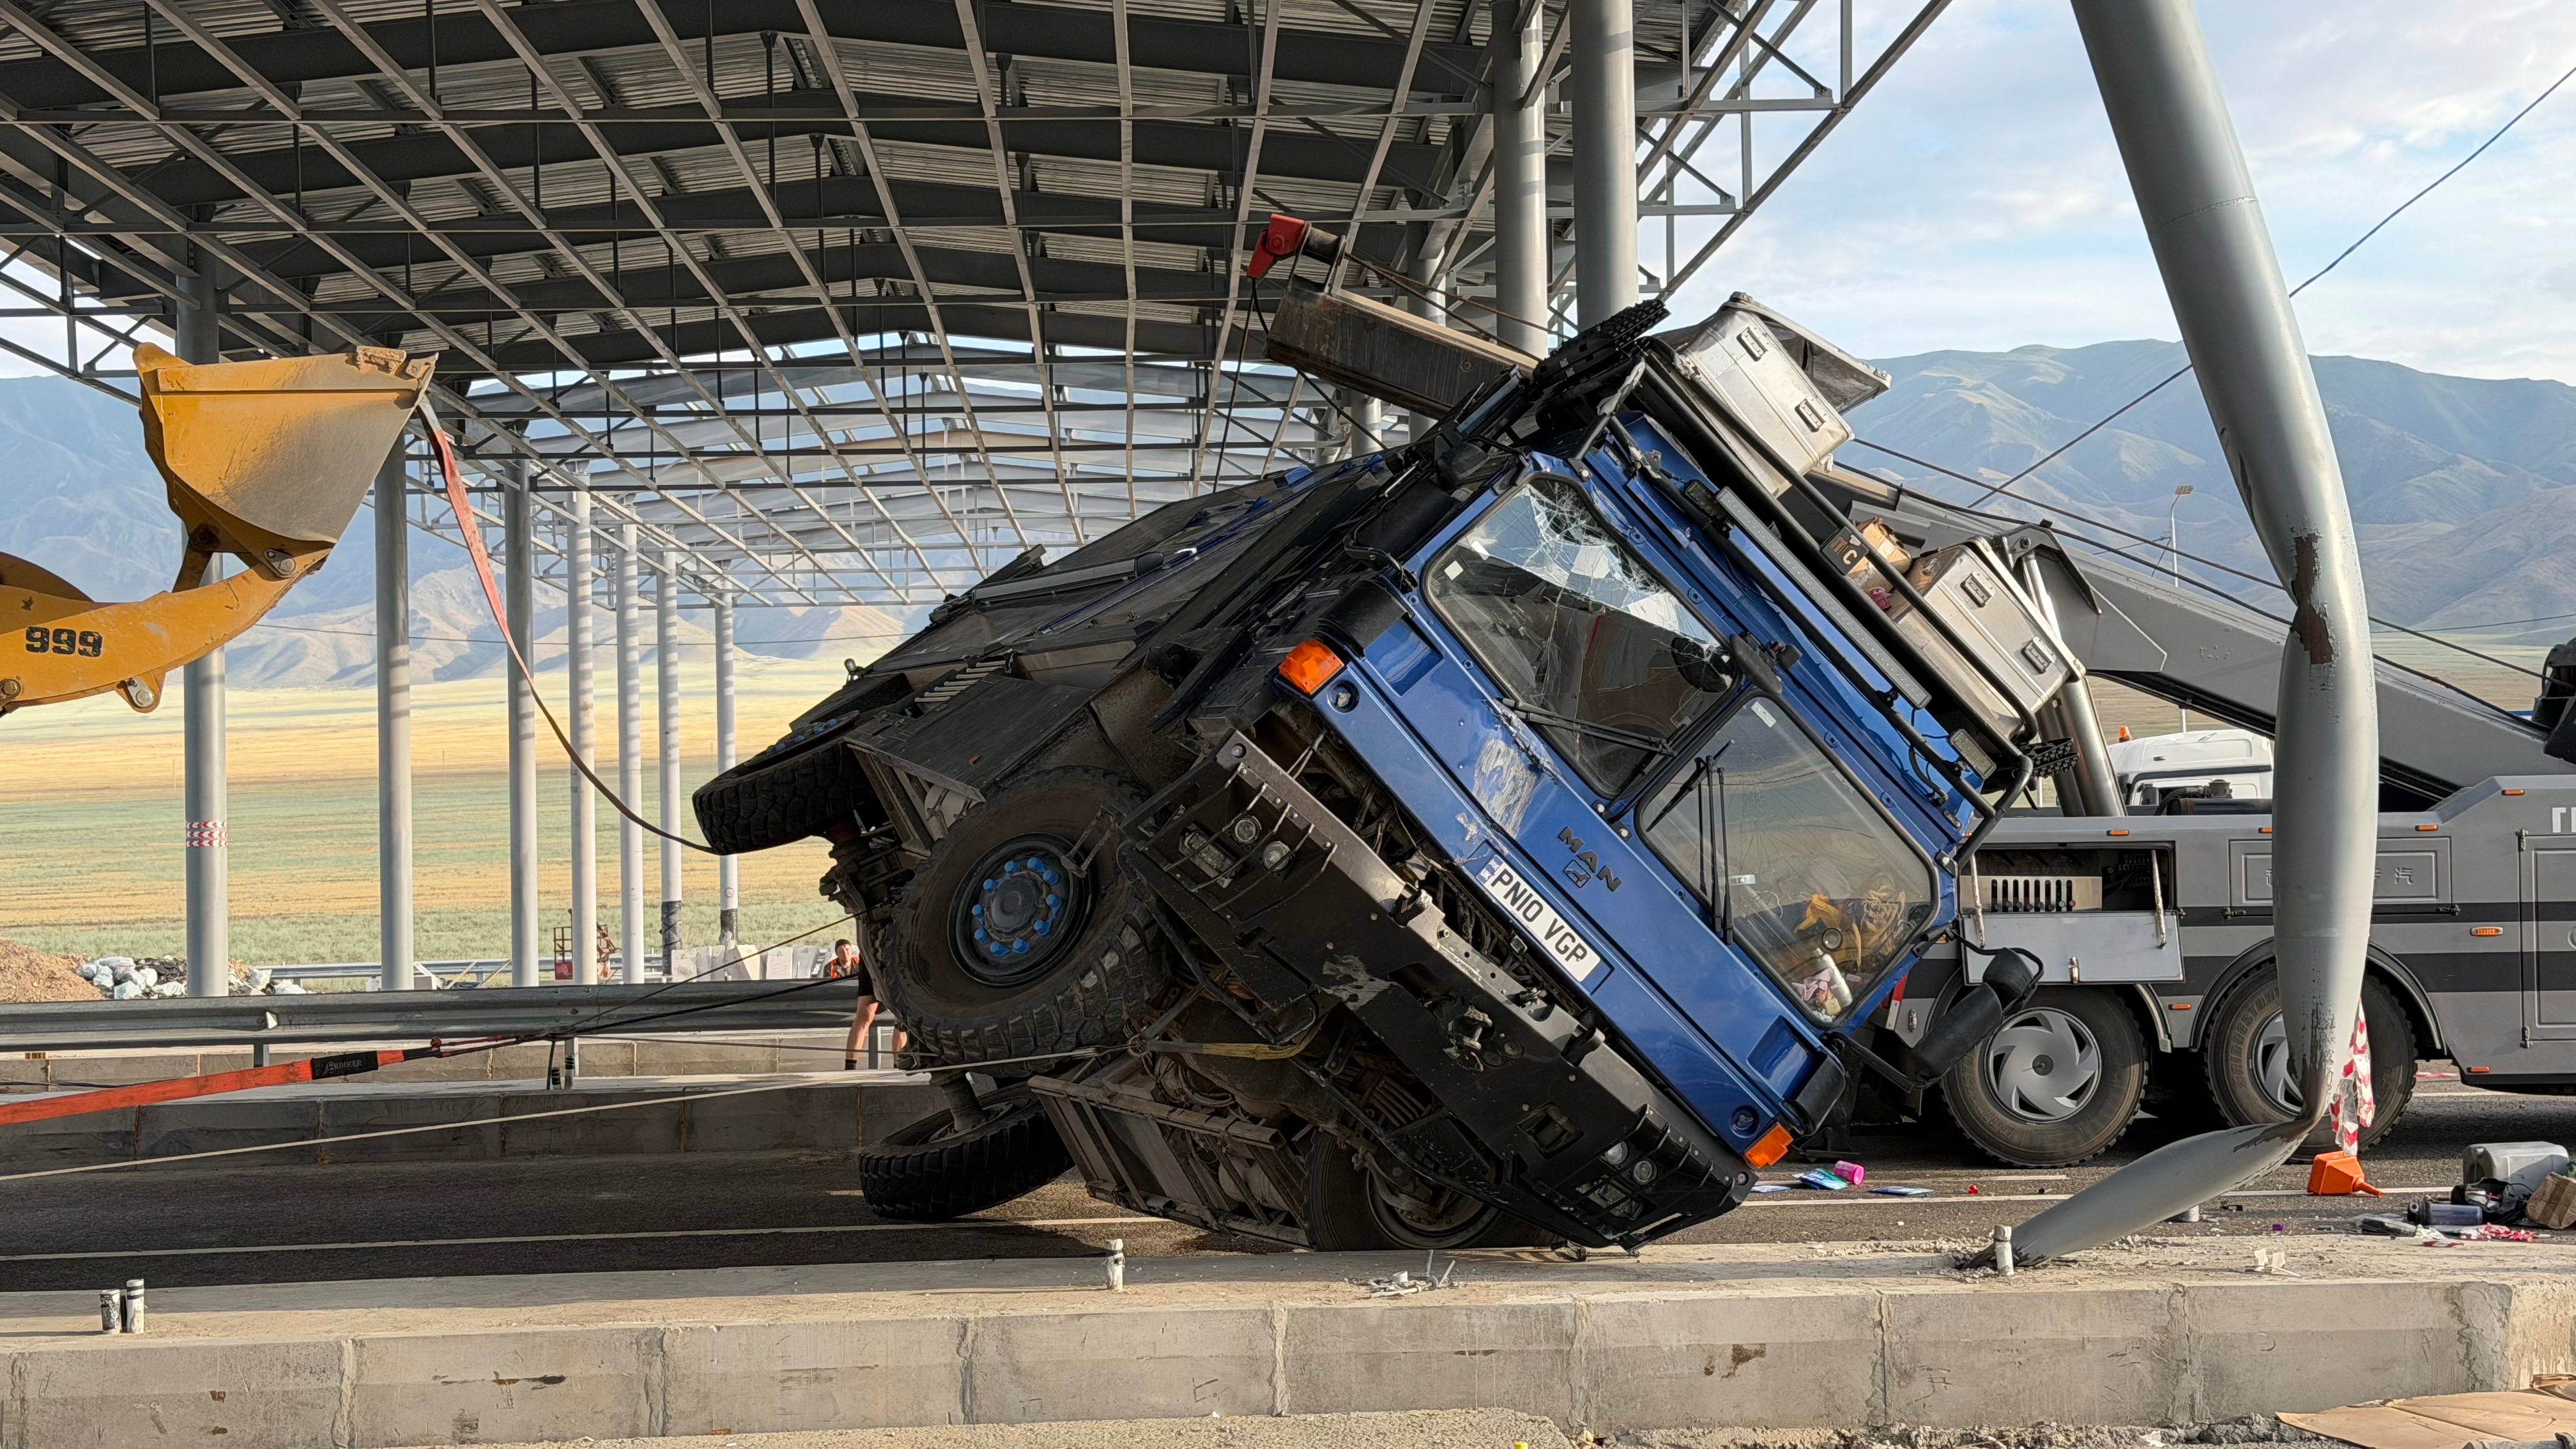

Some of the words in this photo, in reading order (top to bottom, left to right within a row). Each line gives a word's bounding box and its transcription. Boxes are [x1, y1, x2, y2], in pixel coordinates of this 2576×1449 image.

[26, 626, 103, 657] 999
[1480, 868, 1492, 880] UK
[1558, 825, 1623, 893] MAN
[1544, 917, 1588, 962] VGP
